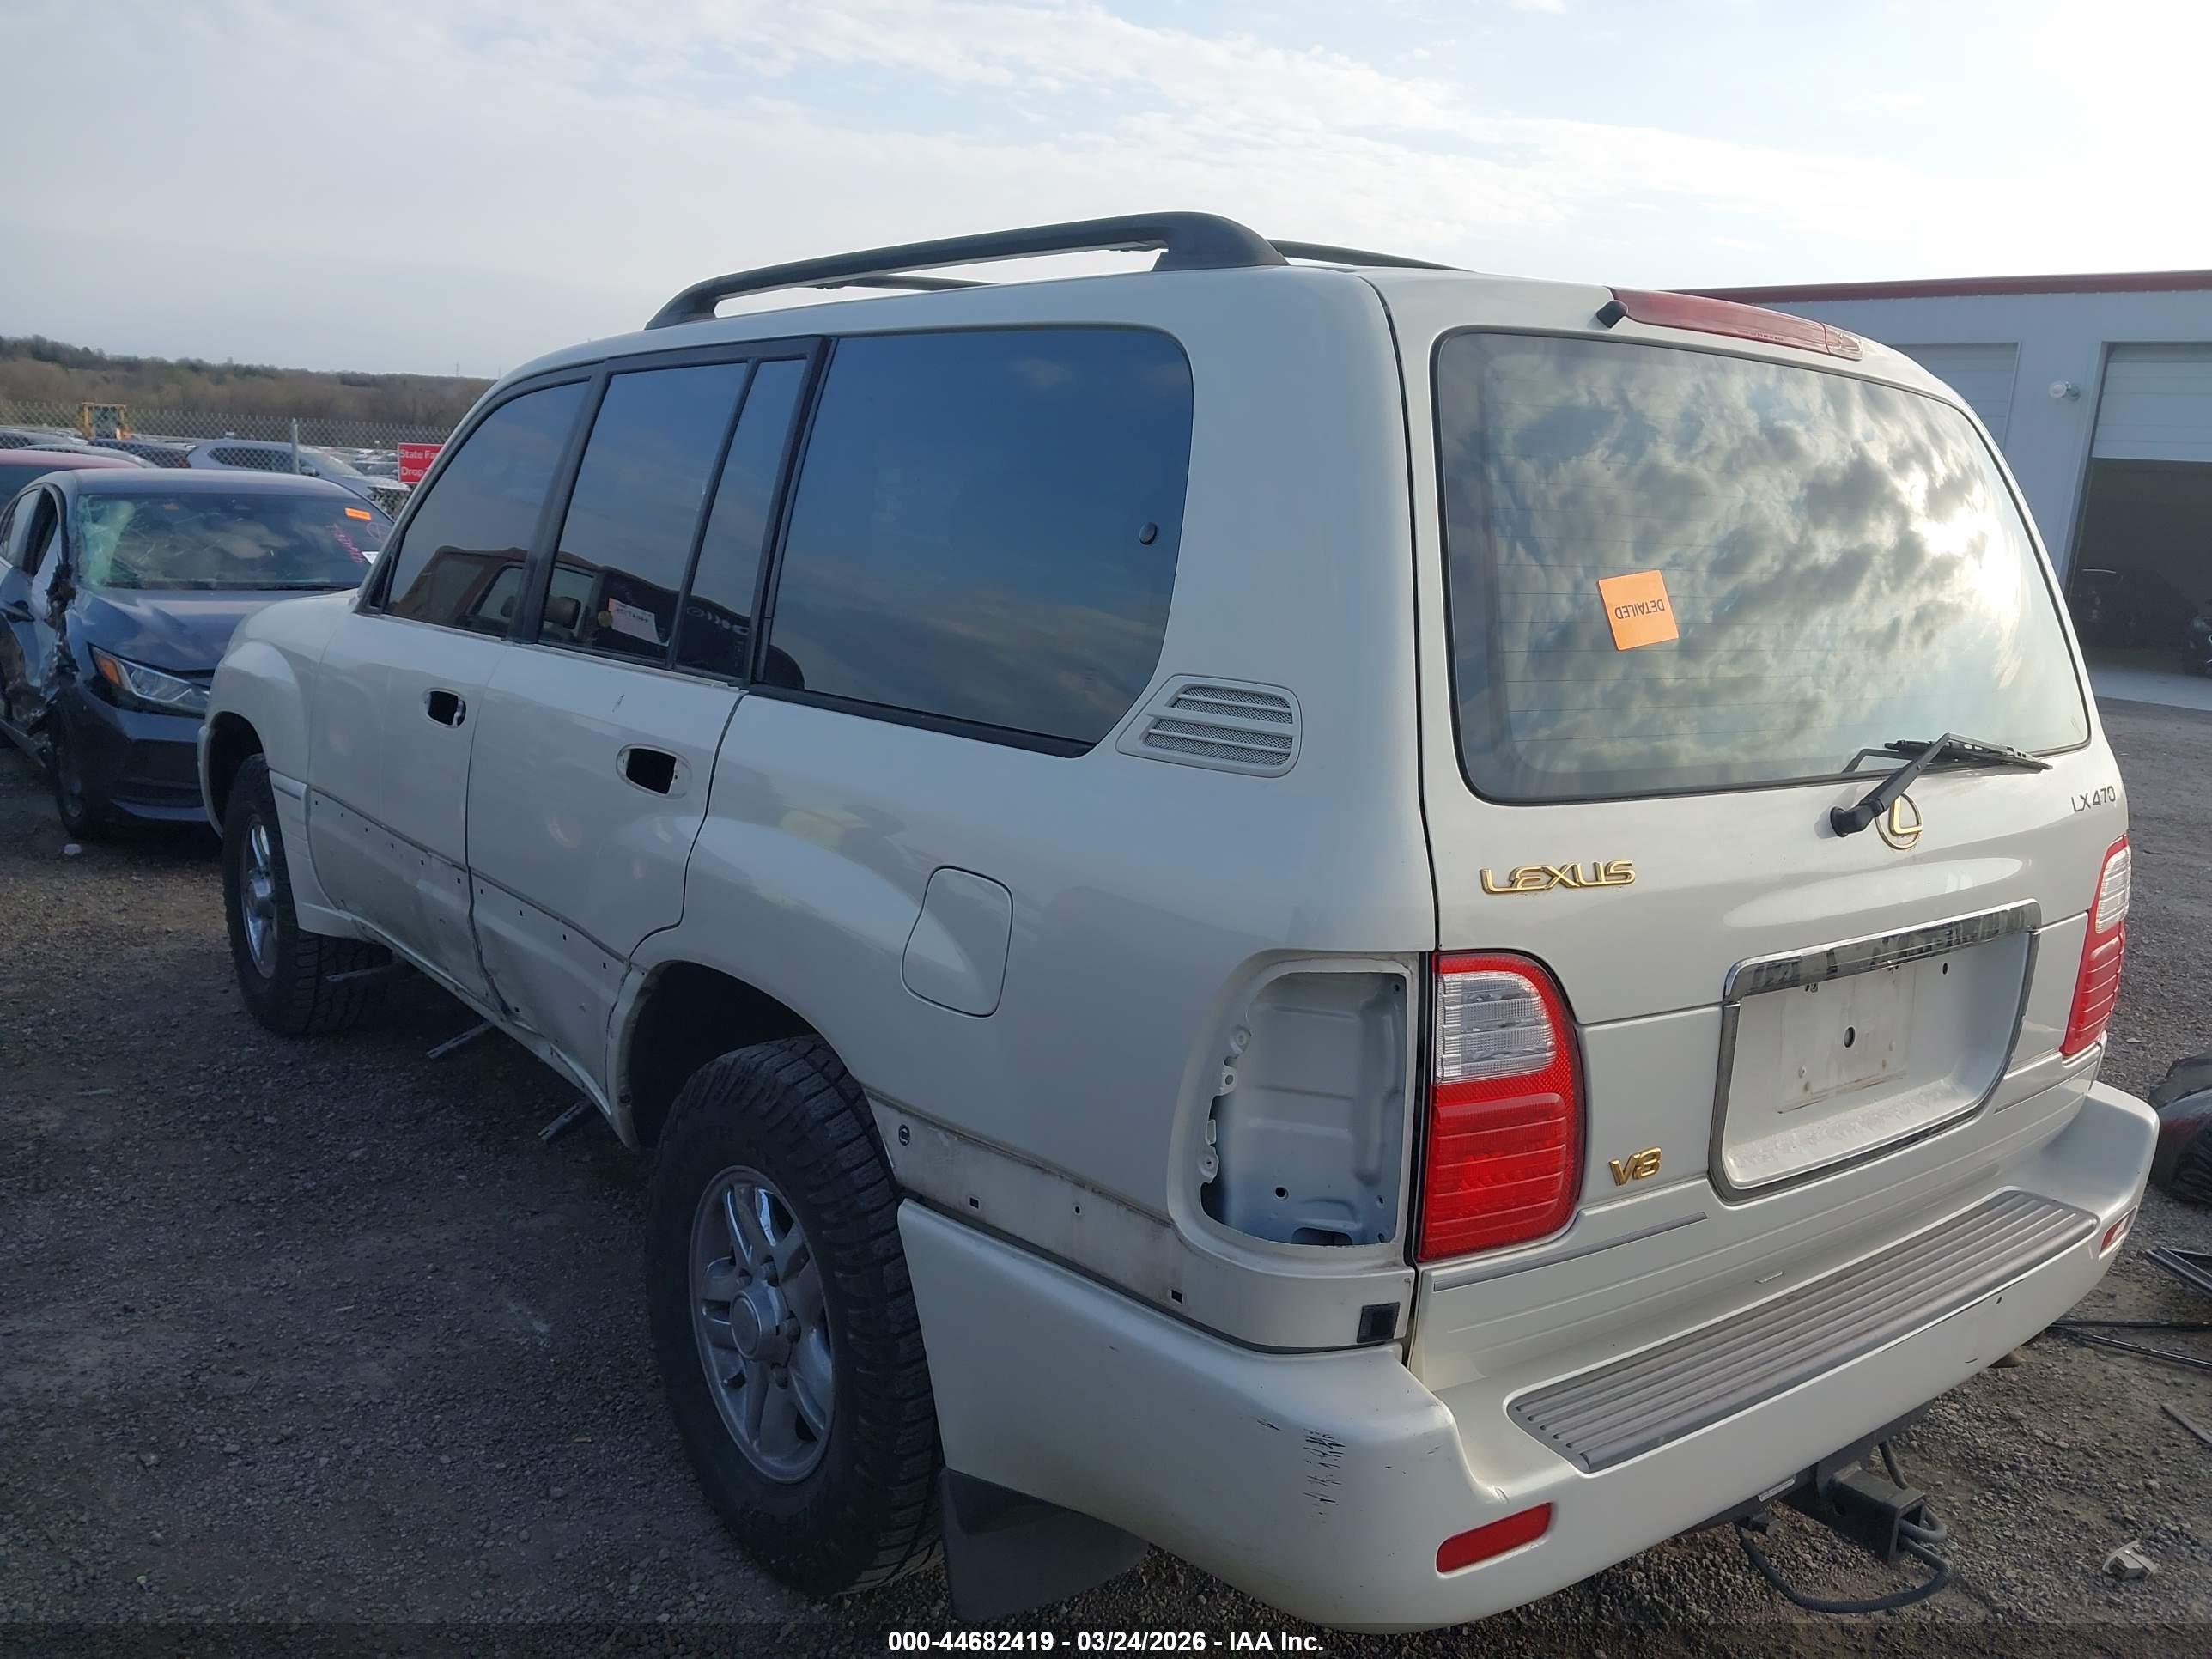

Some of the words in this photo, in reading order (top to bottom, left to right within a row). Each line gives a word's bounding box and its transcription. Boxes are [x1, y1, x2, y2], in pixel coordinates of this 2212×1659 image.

[399, 449, 423, 459] State
[401, 466, 424, 477] Drop
[1614, 599, 1665, 619] DETAILED
[1480, 859, 1636, 894] LEXUS
[1608, 1146, 1662, 1186] V8
